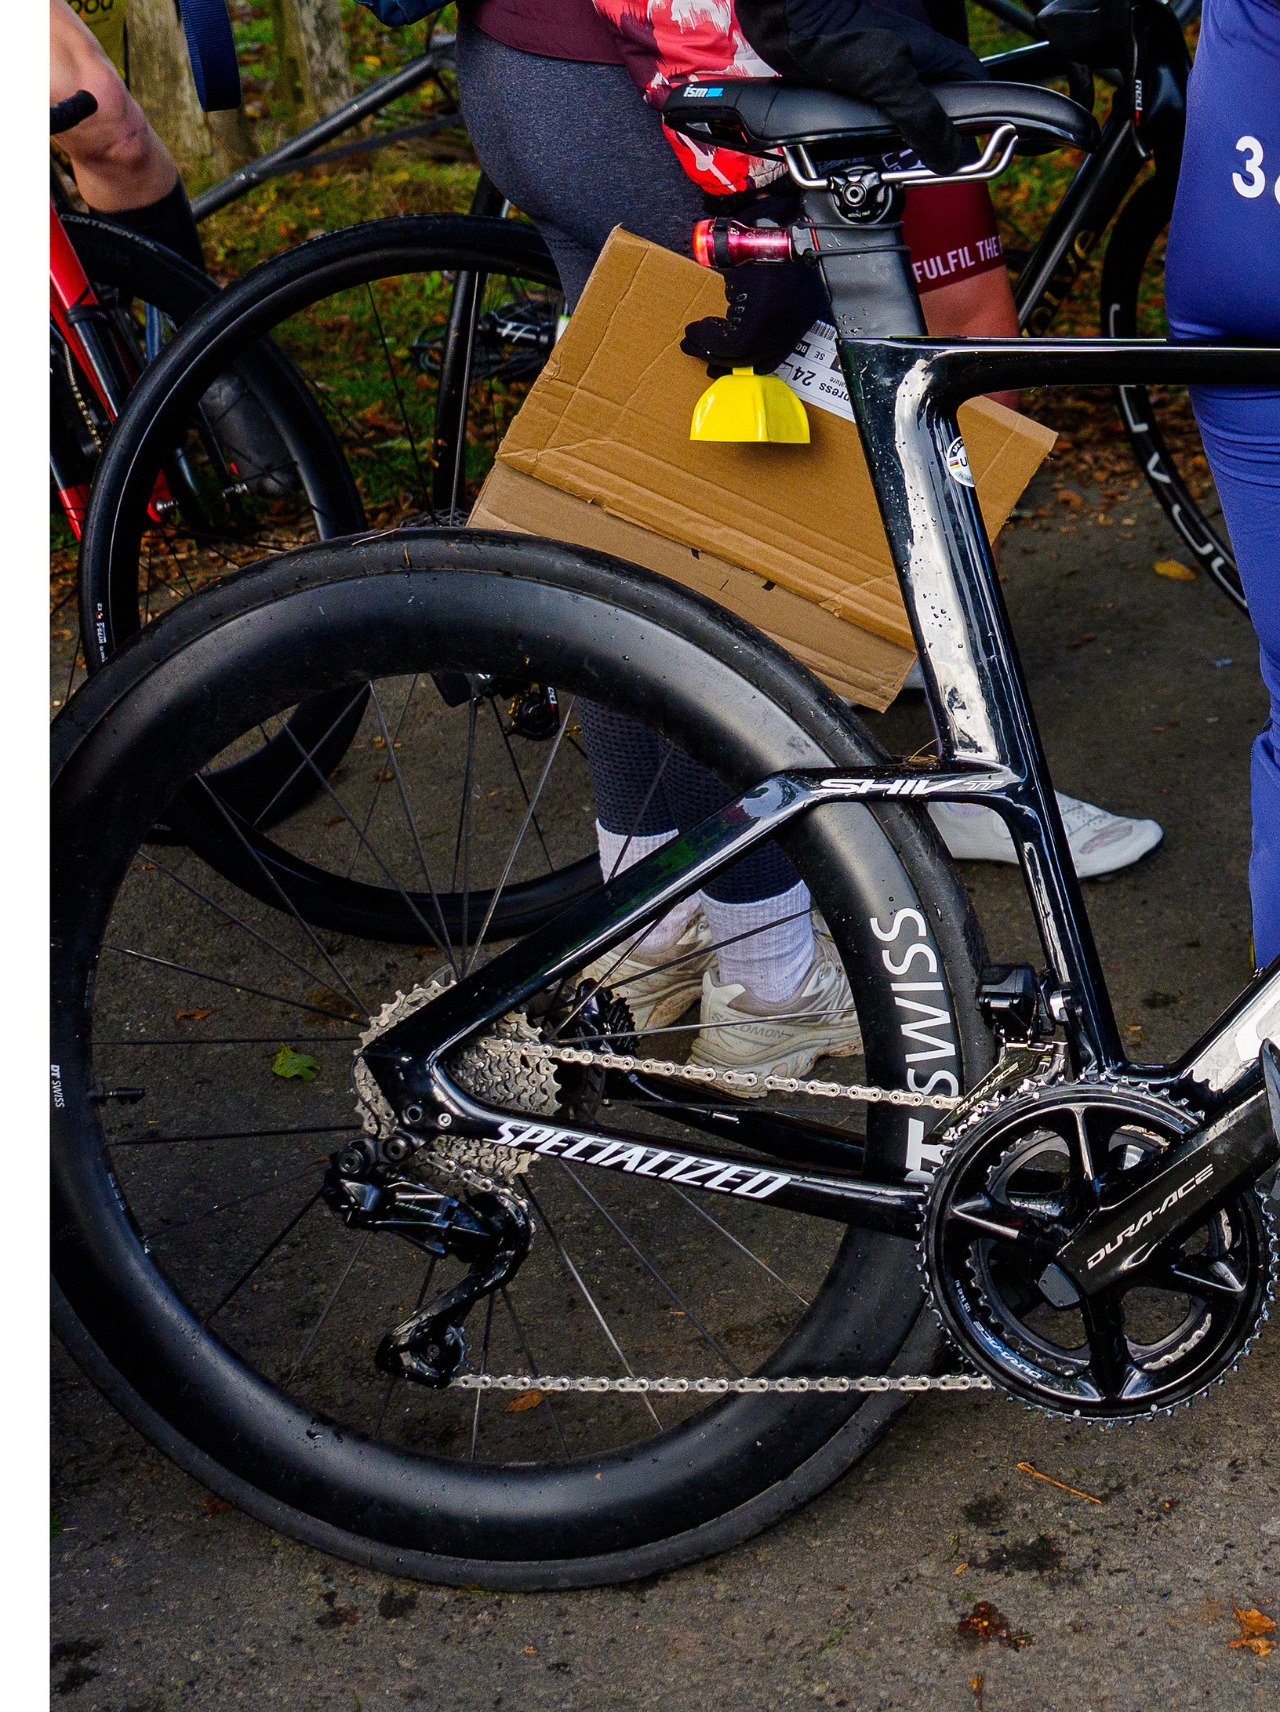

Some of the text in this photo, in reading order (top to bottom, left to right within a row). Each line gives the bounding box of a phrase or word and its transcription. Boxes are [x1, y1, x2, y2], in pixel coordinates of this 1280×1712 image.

[683, 84, 708, 97] ism
[912, 236, 999, 283] FULFIL THE
[792, 366, 817, 387] 24
[51, 1064, 65, 1108] DT SWISS
[483, 1121, 794, 1199] SPECIALIZED
[1087, 1163, 1215, 1270] DURA-ACE
